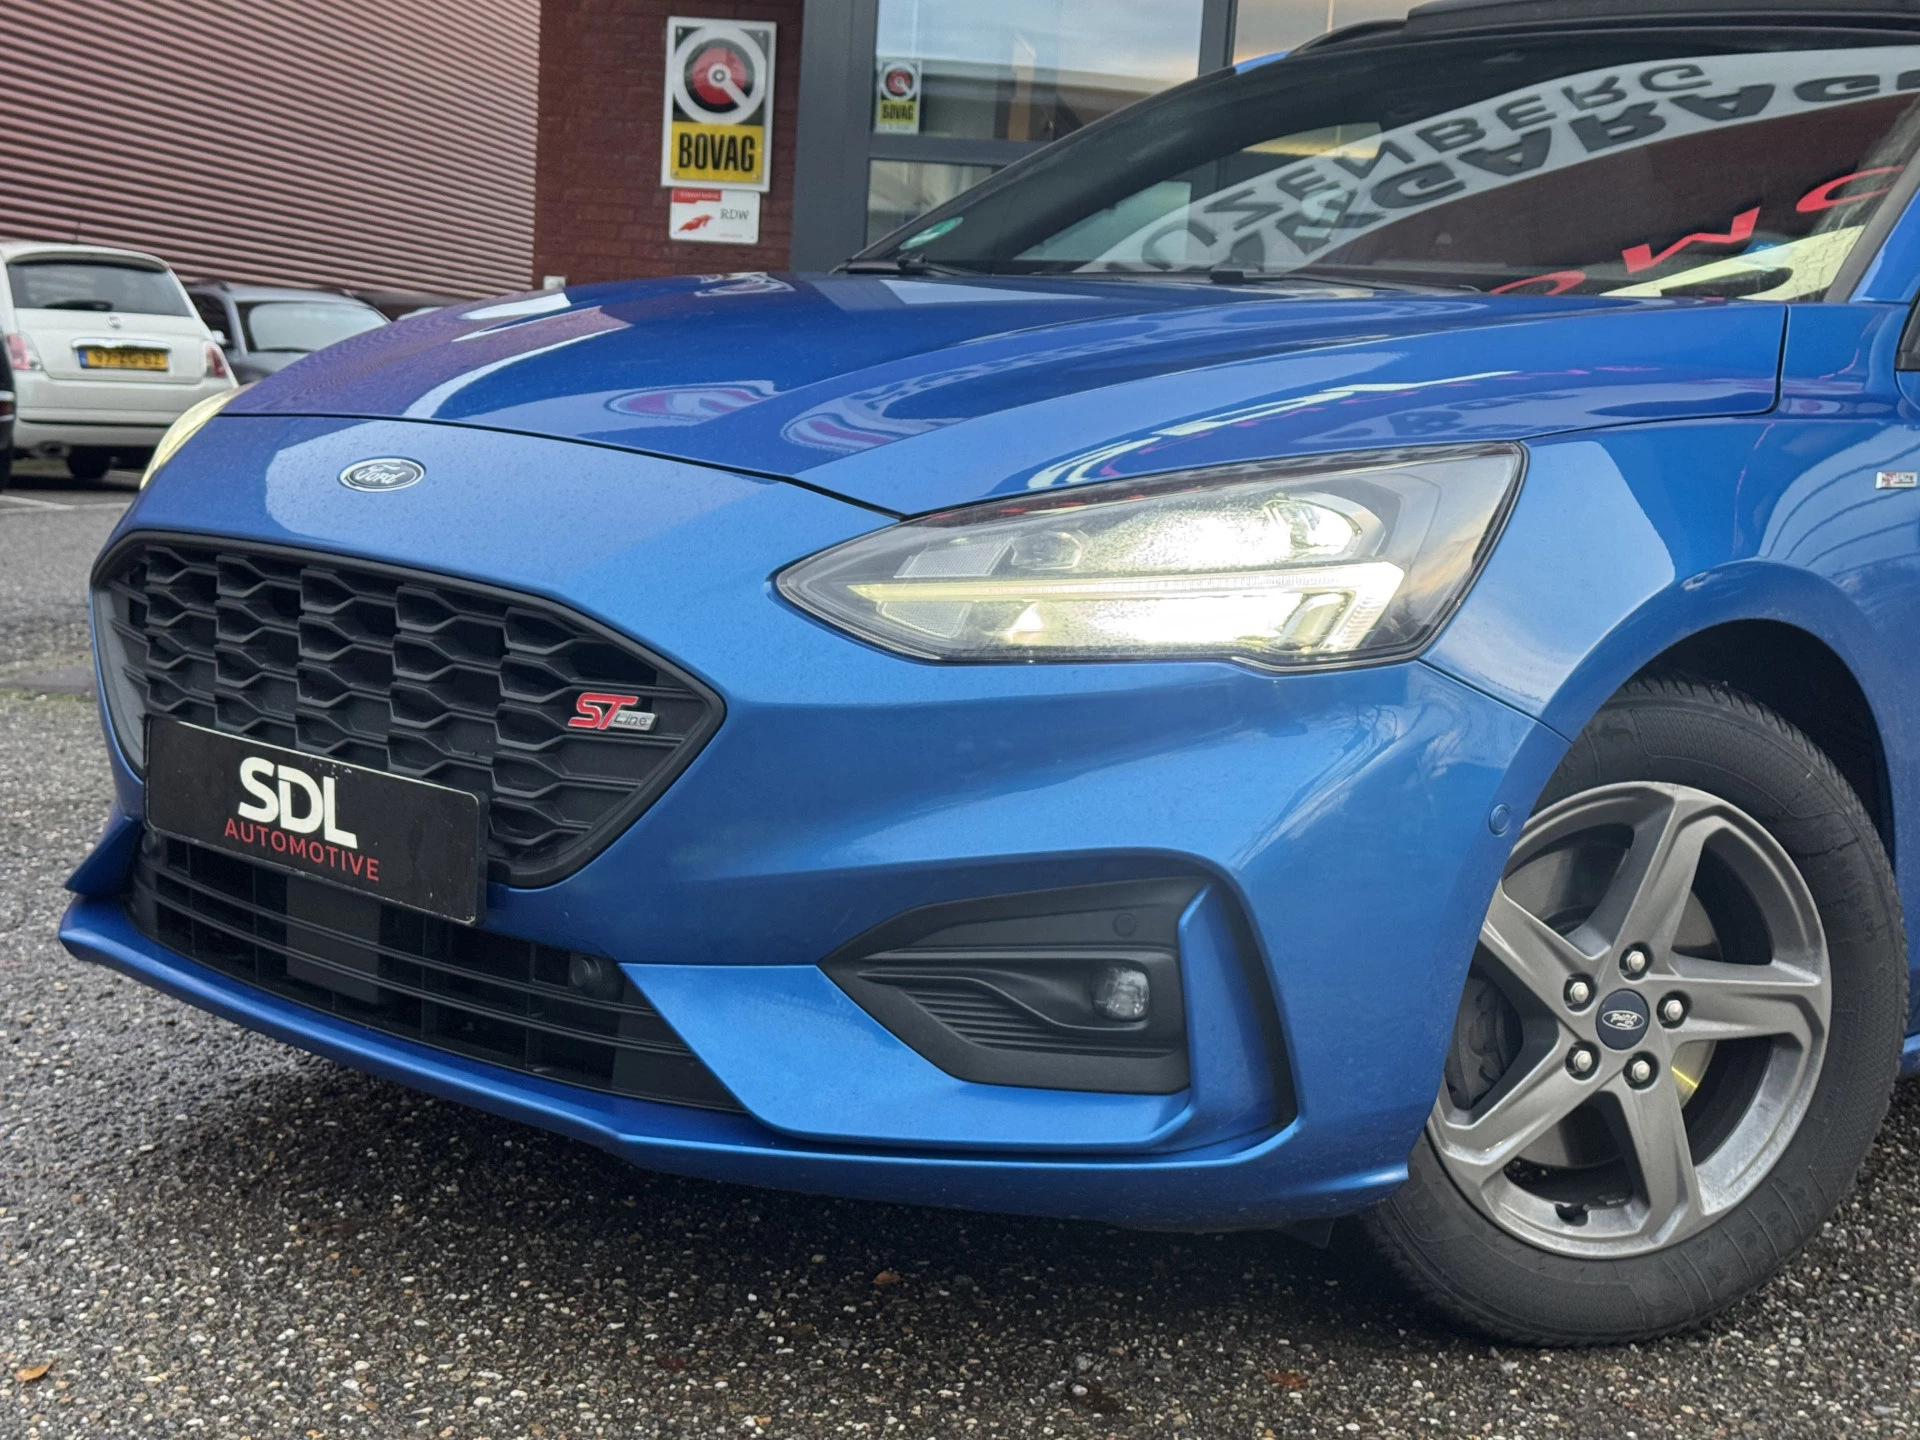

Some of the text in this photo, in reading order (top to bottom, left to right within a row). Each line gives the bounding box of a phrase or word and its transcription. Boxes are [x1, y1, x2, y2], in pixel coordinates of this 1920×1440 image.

[882, 103, 914, 121] BOVAG
[678, 132, 756, 173] BOVAG
[720, 208, 749, 221] RDW
[354, 463, 407, 485] Ford
[567, 691, 648, 731] ST Line
[237, 755, 359, 850] SDL
[223, 817, 380, 882] AUTOMOTIVE
